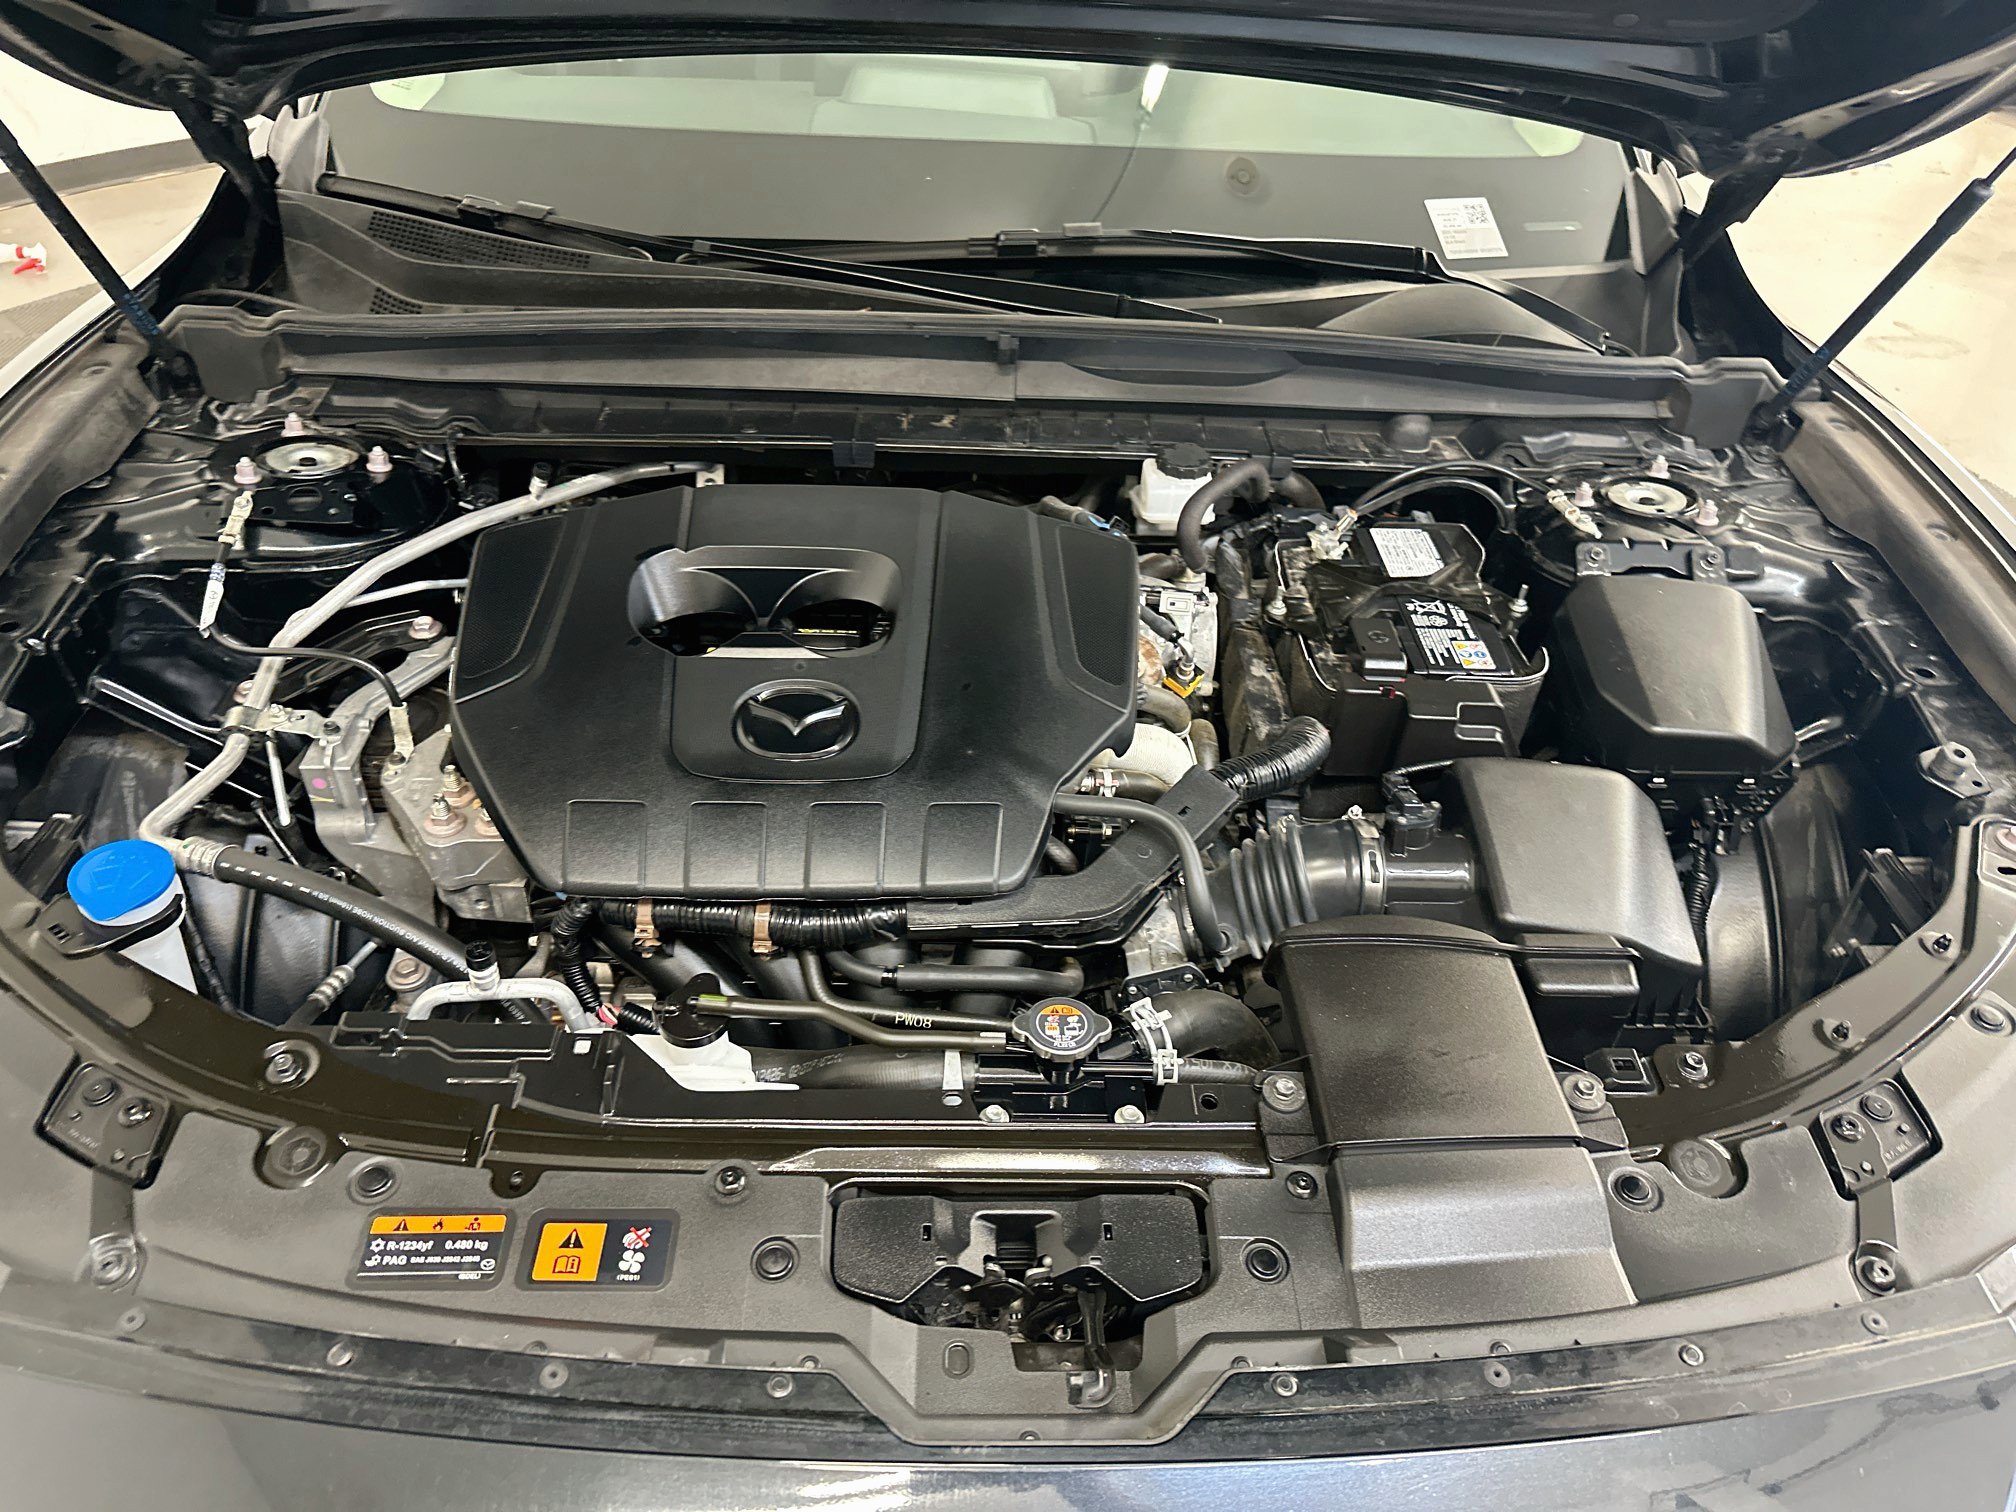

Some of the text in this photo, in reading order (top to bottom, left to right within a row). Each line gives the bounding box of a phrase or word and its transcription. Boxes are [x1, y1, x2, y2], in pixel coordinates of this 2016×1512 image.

[352, 907, 373, 921] HOSE
[372, 915, 406, 937] SUCTION
[894, 1012, 932, 1029] PW08
[386, 1240, 434, 1252] R-1234yf
[474, 1239, 489, 1252] kg
[382, 1255, 407, 1266] PAG
